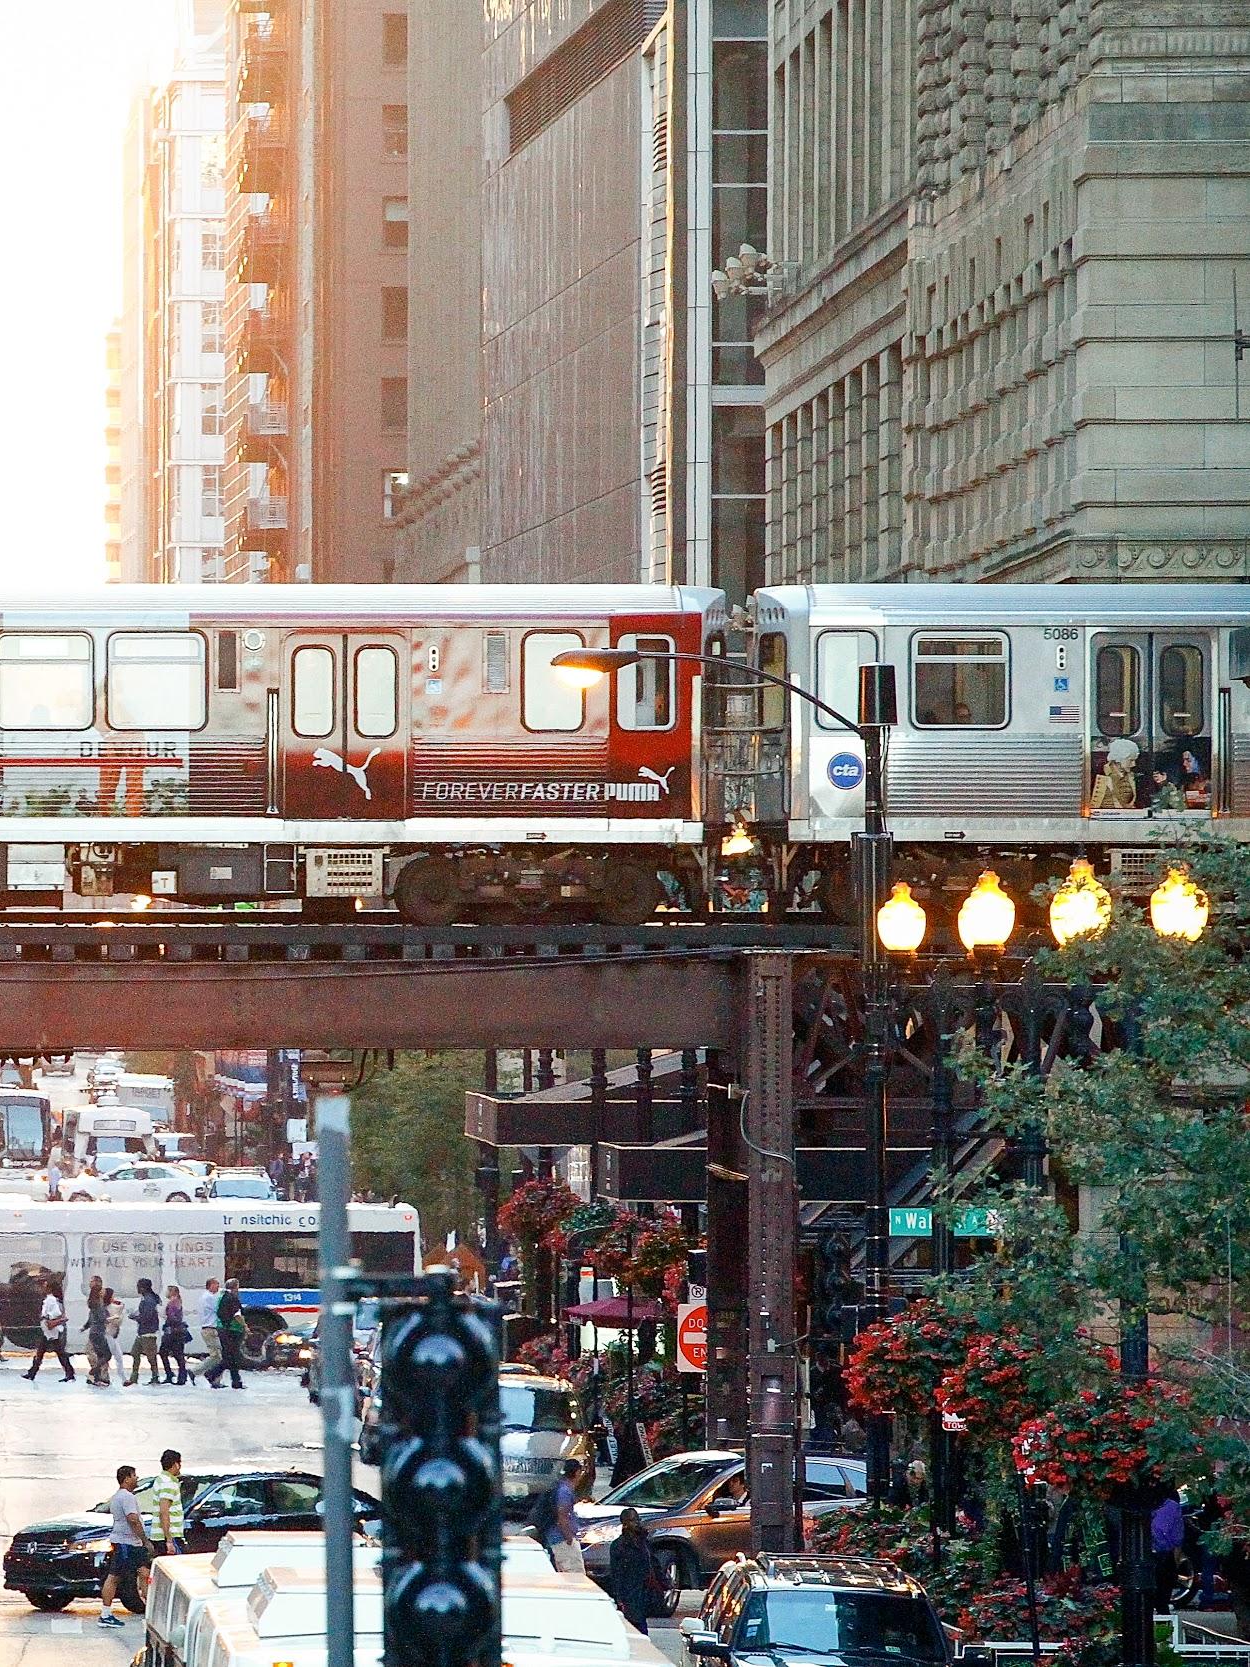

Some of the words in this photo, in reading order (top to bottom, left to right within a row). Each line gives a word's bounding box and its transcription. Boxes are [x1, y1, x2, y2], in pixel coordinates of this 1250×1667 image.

[1043, 628, 1079, 641] 5086
[832, 763, 859, 776] cta
[604, 783, 660, 801] PUMA
[102, 1241, 129, 1254] USE
[132, 1241, 164, 1254] YOUR
[106, 1257, 129, 1268] ALL
[688, 1318, 704, 1329] DO
